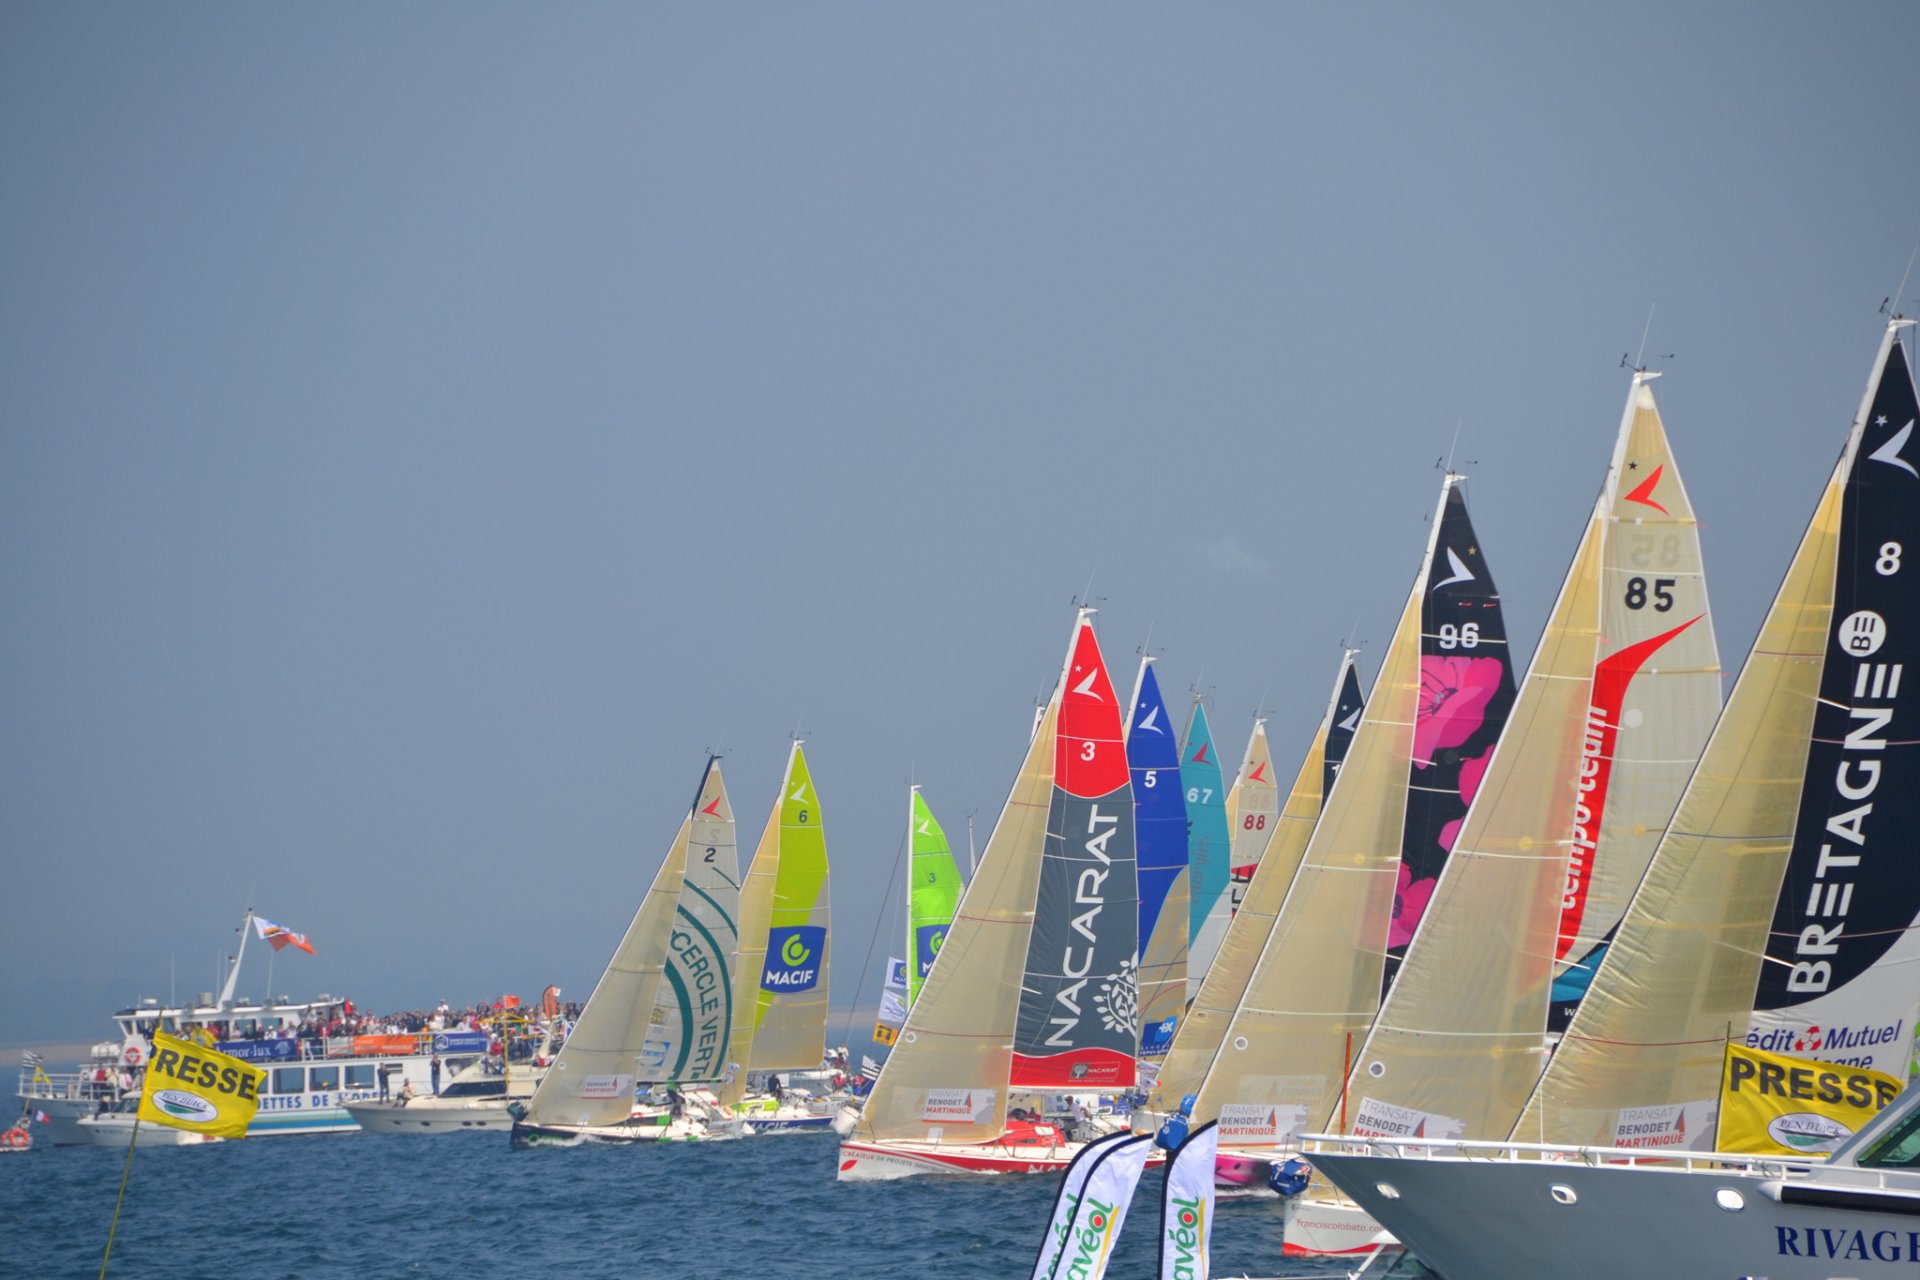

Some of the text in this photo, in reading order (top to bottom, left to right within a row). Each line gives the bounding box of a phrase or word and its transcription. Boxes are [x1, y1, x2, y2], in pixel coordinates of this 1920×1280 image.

[1875, 541, 1902, 576] 8
[1624, 576, 1676, 613] 85
[1438, 622, 1480, 650] 96
[1080, 741, 1096, 762] 3
[1144, 770, 1157, 788] 5
[1187, 787, 1213, 805] 67
[799, 809, 808, 824] 6
[1243, 814, 1266, 831] 88
[1786, 662, 1903, 993] BRETAGNE
[703, 847, 717, 863] 2
[928, 873, 936, 883] 3
[1044, 803, 1119, 1047] NACARAT
[765, 968, 815, 986] MACIF
[670, 932, 719, 1075] CERCLE VERT
[1823, 1019, 1903, 1051] Mutuel
[1730, 1056, 1898, 1111] PRESSE
[312, 1095, 328, 1107] DE
[928, 1098, 962, 1106] BENODET
[926, 1106, 972, 1115] MARTINIQUE
[1224, 1106, 1267, 1115] TRANSAT
[1364, 1100, 1416, 1122] TRANSAT
[1622, 1107, 1675, 1122] TRANSAT
[1221, 1117, 1264, 1125] BENODET
[1357, 1113, 1411, 1135] BENODET
[1617, 1121, 1671, 1135] BENODET
[1780, 1119, 1804, 1130] PEN
[1218, 1127, 1277, 1136] MARTINIQUE
[1615, 1132, 1685, 1149] MARTINIQUE
